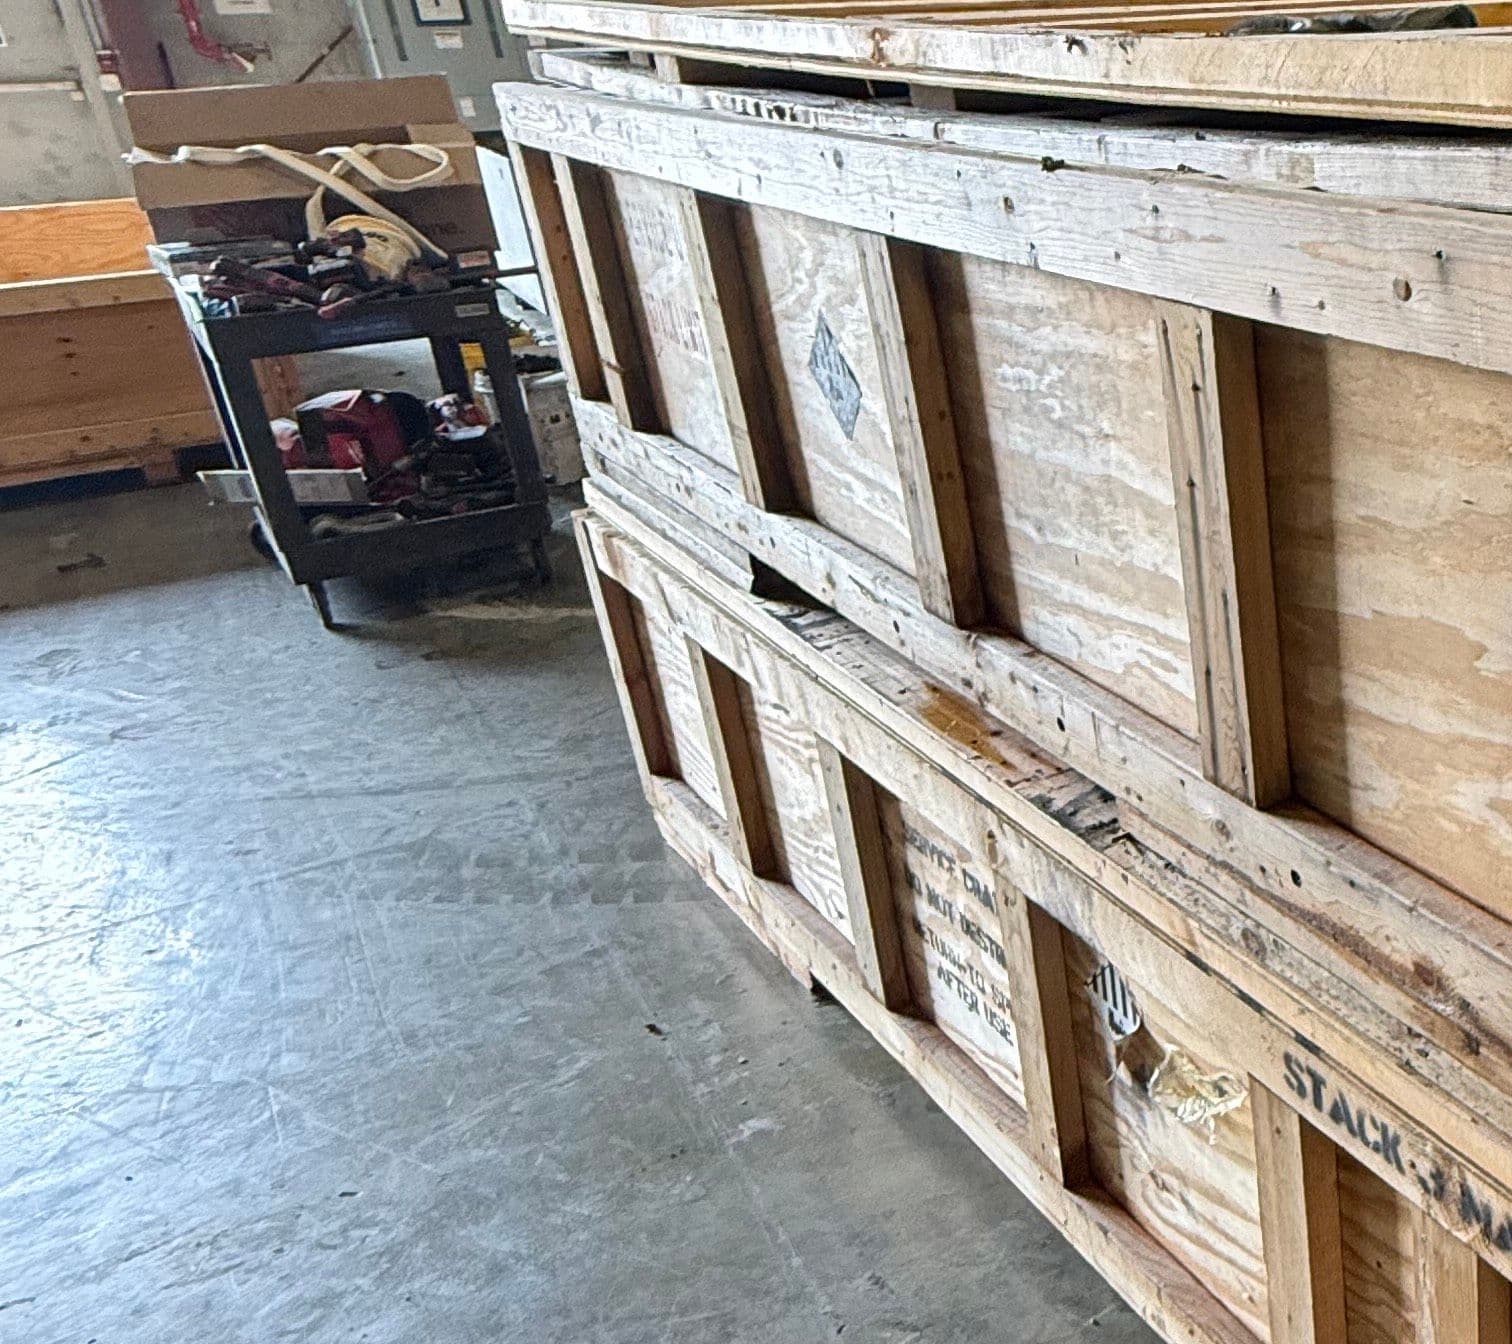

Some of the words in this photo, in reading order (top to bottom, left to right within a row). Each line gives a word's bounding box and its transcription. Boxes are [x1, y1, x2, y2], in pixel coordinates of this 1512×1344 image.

[937, 963, 980, 1016] AFTER
[984, 1000, 1013, 1047] USE
[1283, 1050, 1406, 1175] STACK
[1415, 1165, 1446, 1202] 3
